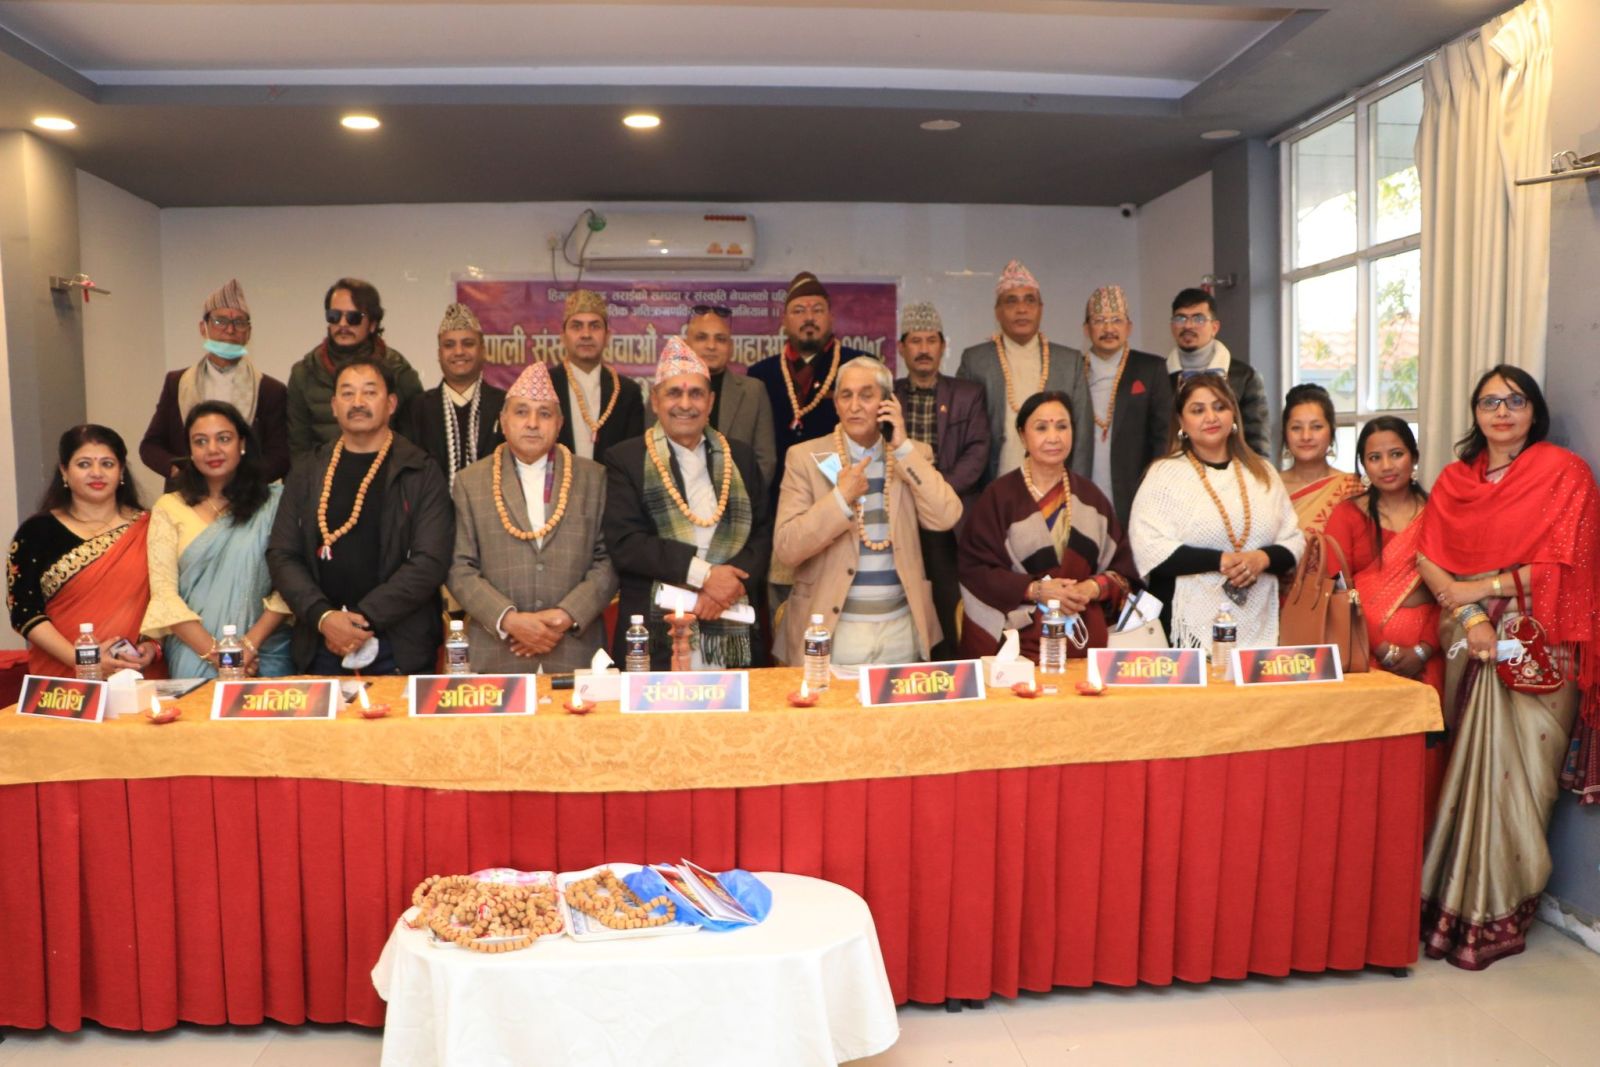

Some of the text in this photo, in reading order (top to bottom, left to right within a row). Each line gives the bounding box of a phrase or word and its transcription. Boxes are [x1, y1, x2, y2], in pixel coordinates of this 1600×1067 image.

[482, 324, 527, 366] पाली
[1116, 656, 1179, 677] अतिथि
[1259, 653, 1317, 676] अतिथि
[642, 680, 727, 704] संयोजक
[890, 670, 956, 696] अतिथि
[38, 687, 85, 712] अतिथि
[242, 688, 309, 711] अतिथि
[438, 683, 505, 708] अतिथि
